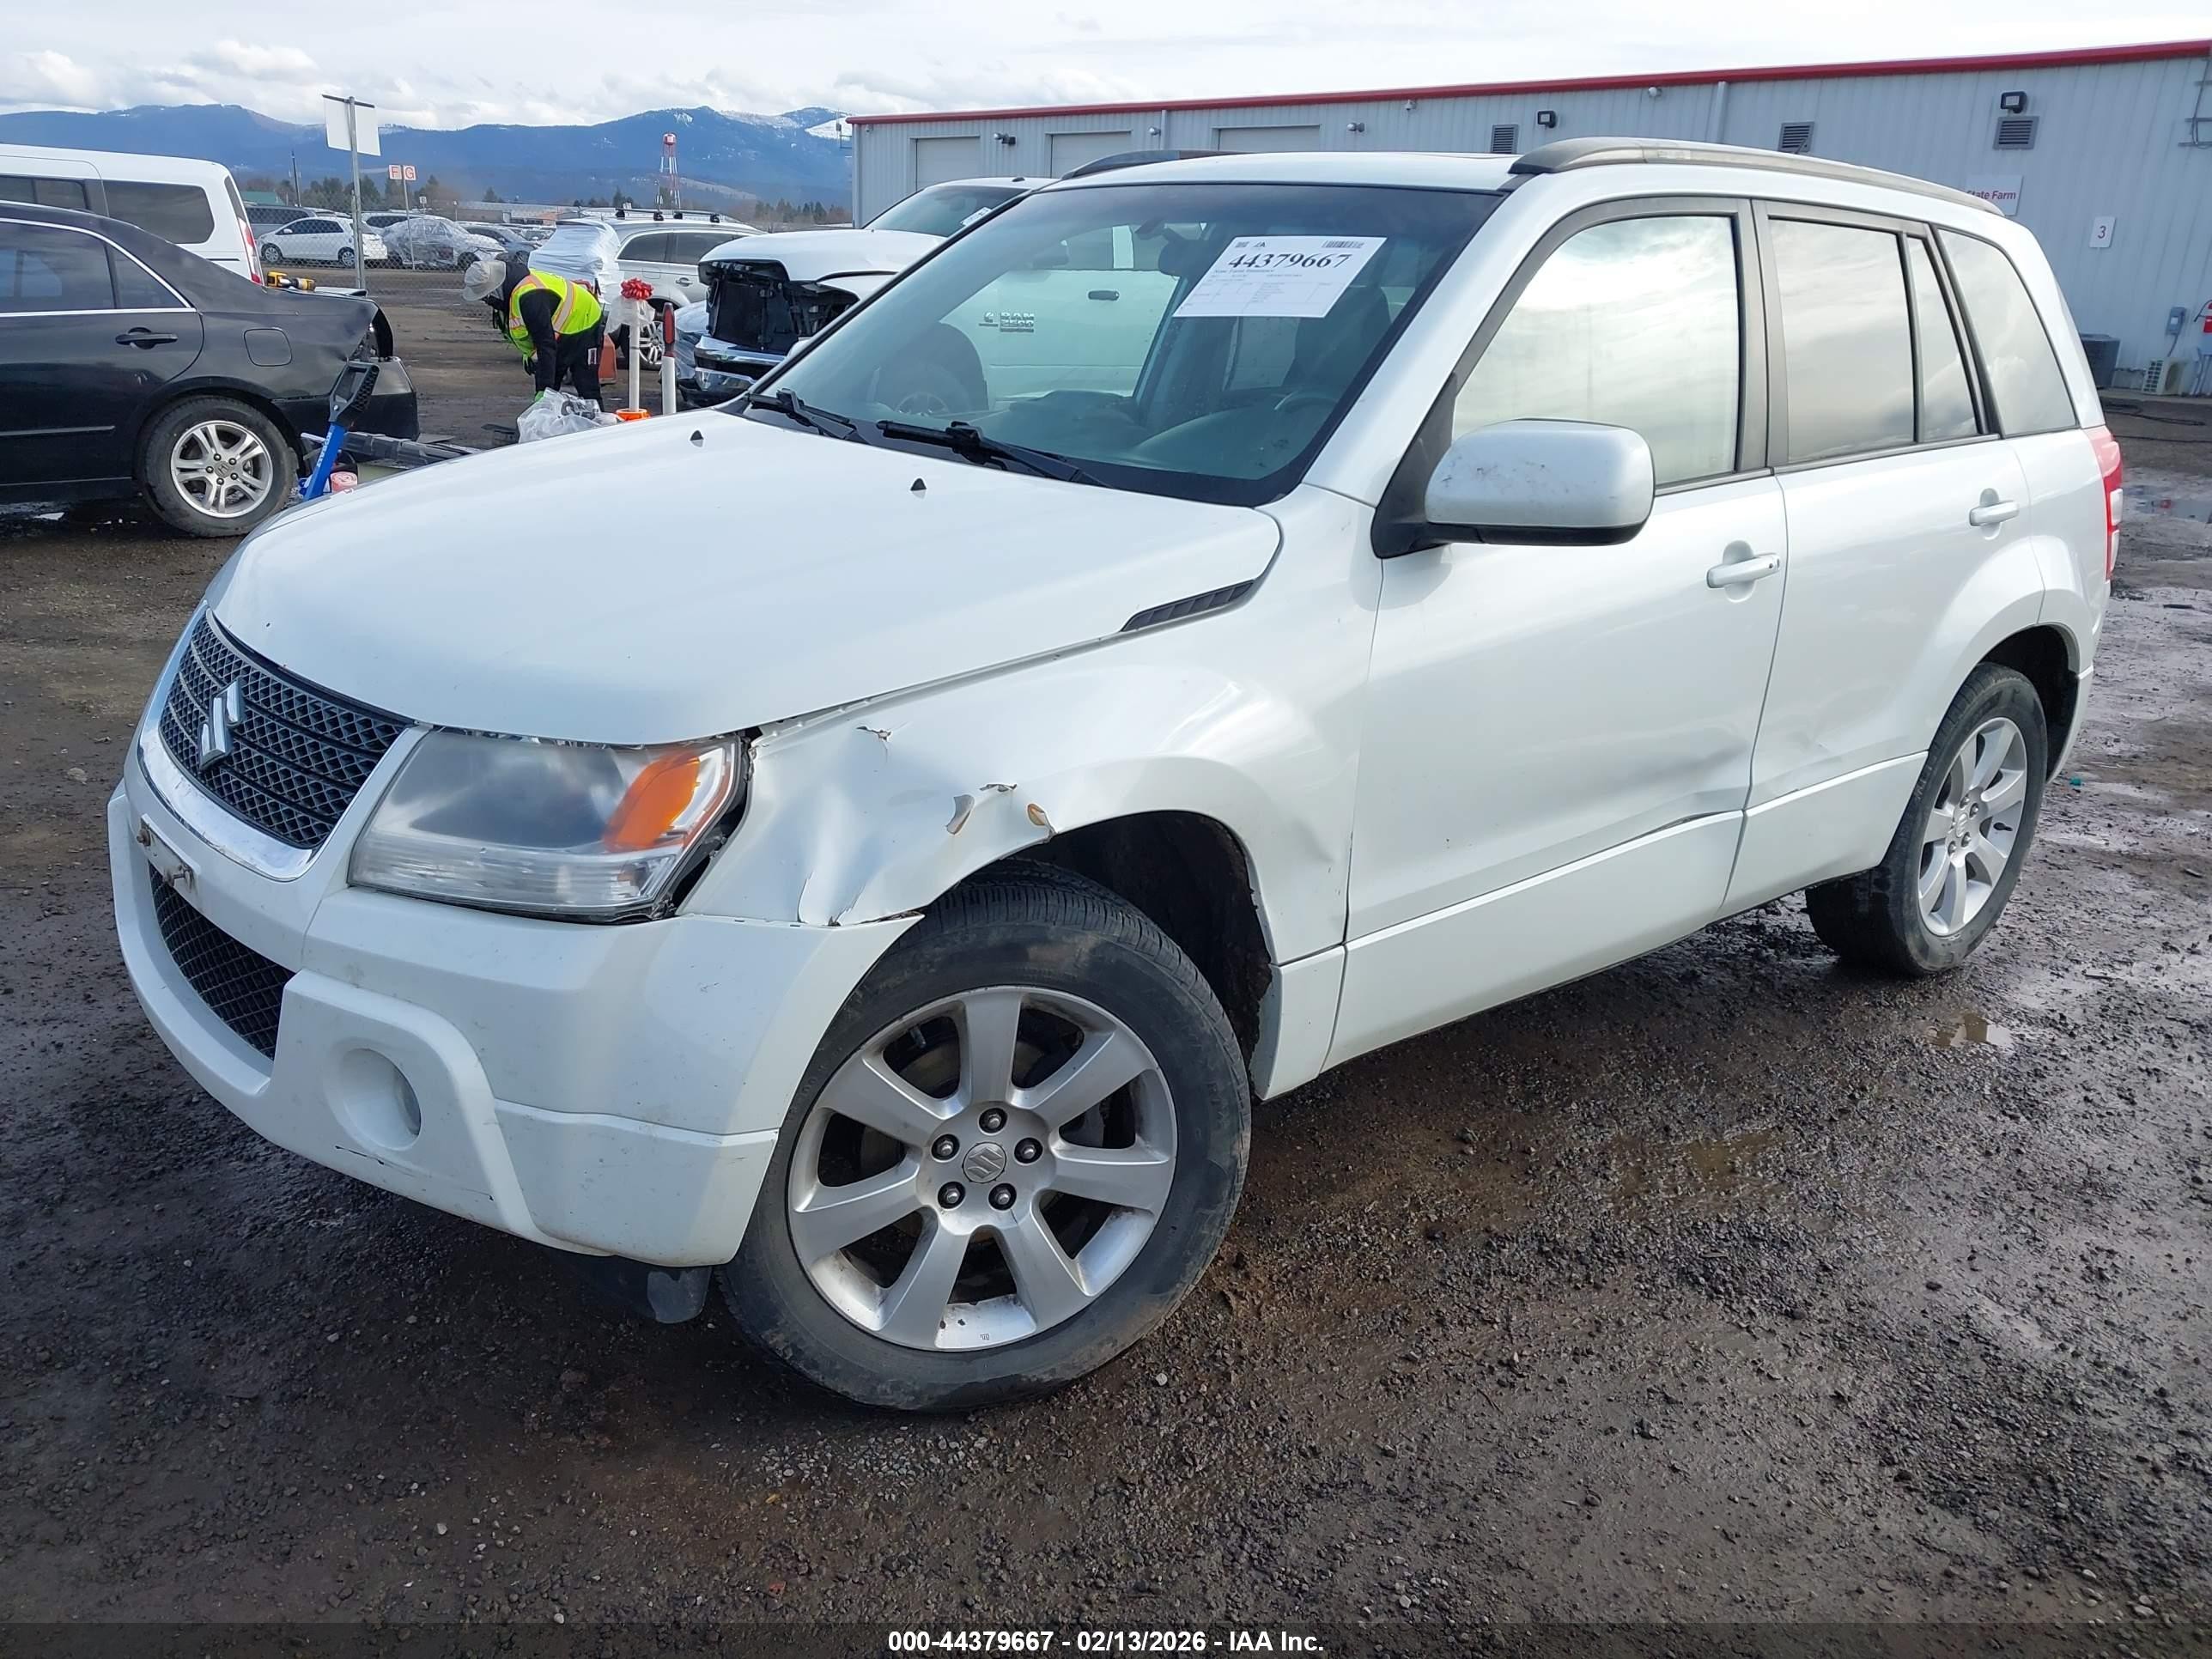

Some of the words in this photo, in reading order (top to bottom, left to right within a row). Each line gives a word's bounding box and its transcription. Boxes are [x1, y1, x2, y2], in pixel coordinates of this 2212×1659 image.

[392, 166, 399, 178] F
[405, 167, 415, 179] G
[1991, 190, 2016, 200] Farm
[2097, 225, 2106, 239] 3
[1228, 252, 1353, 269] 44379667
[1000, 312, 1035, 320] RAM
